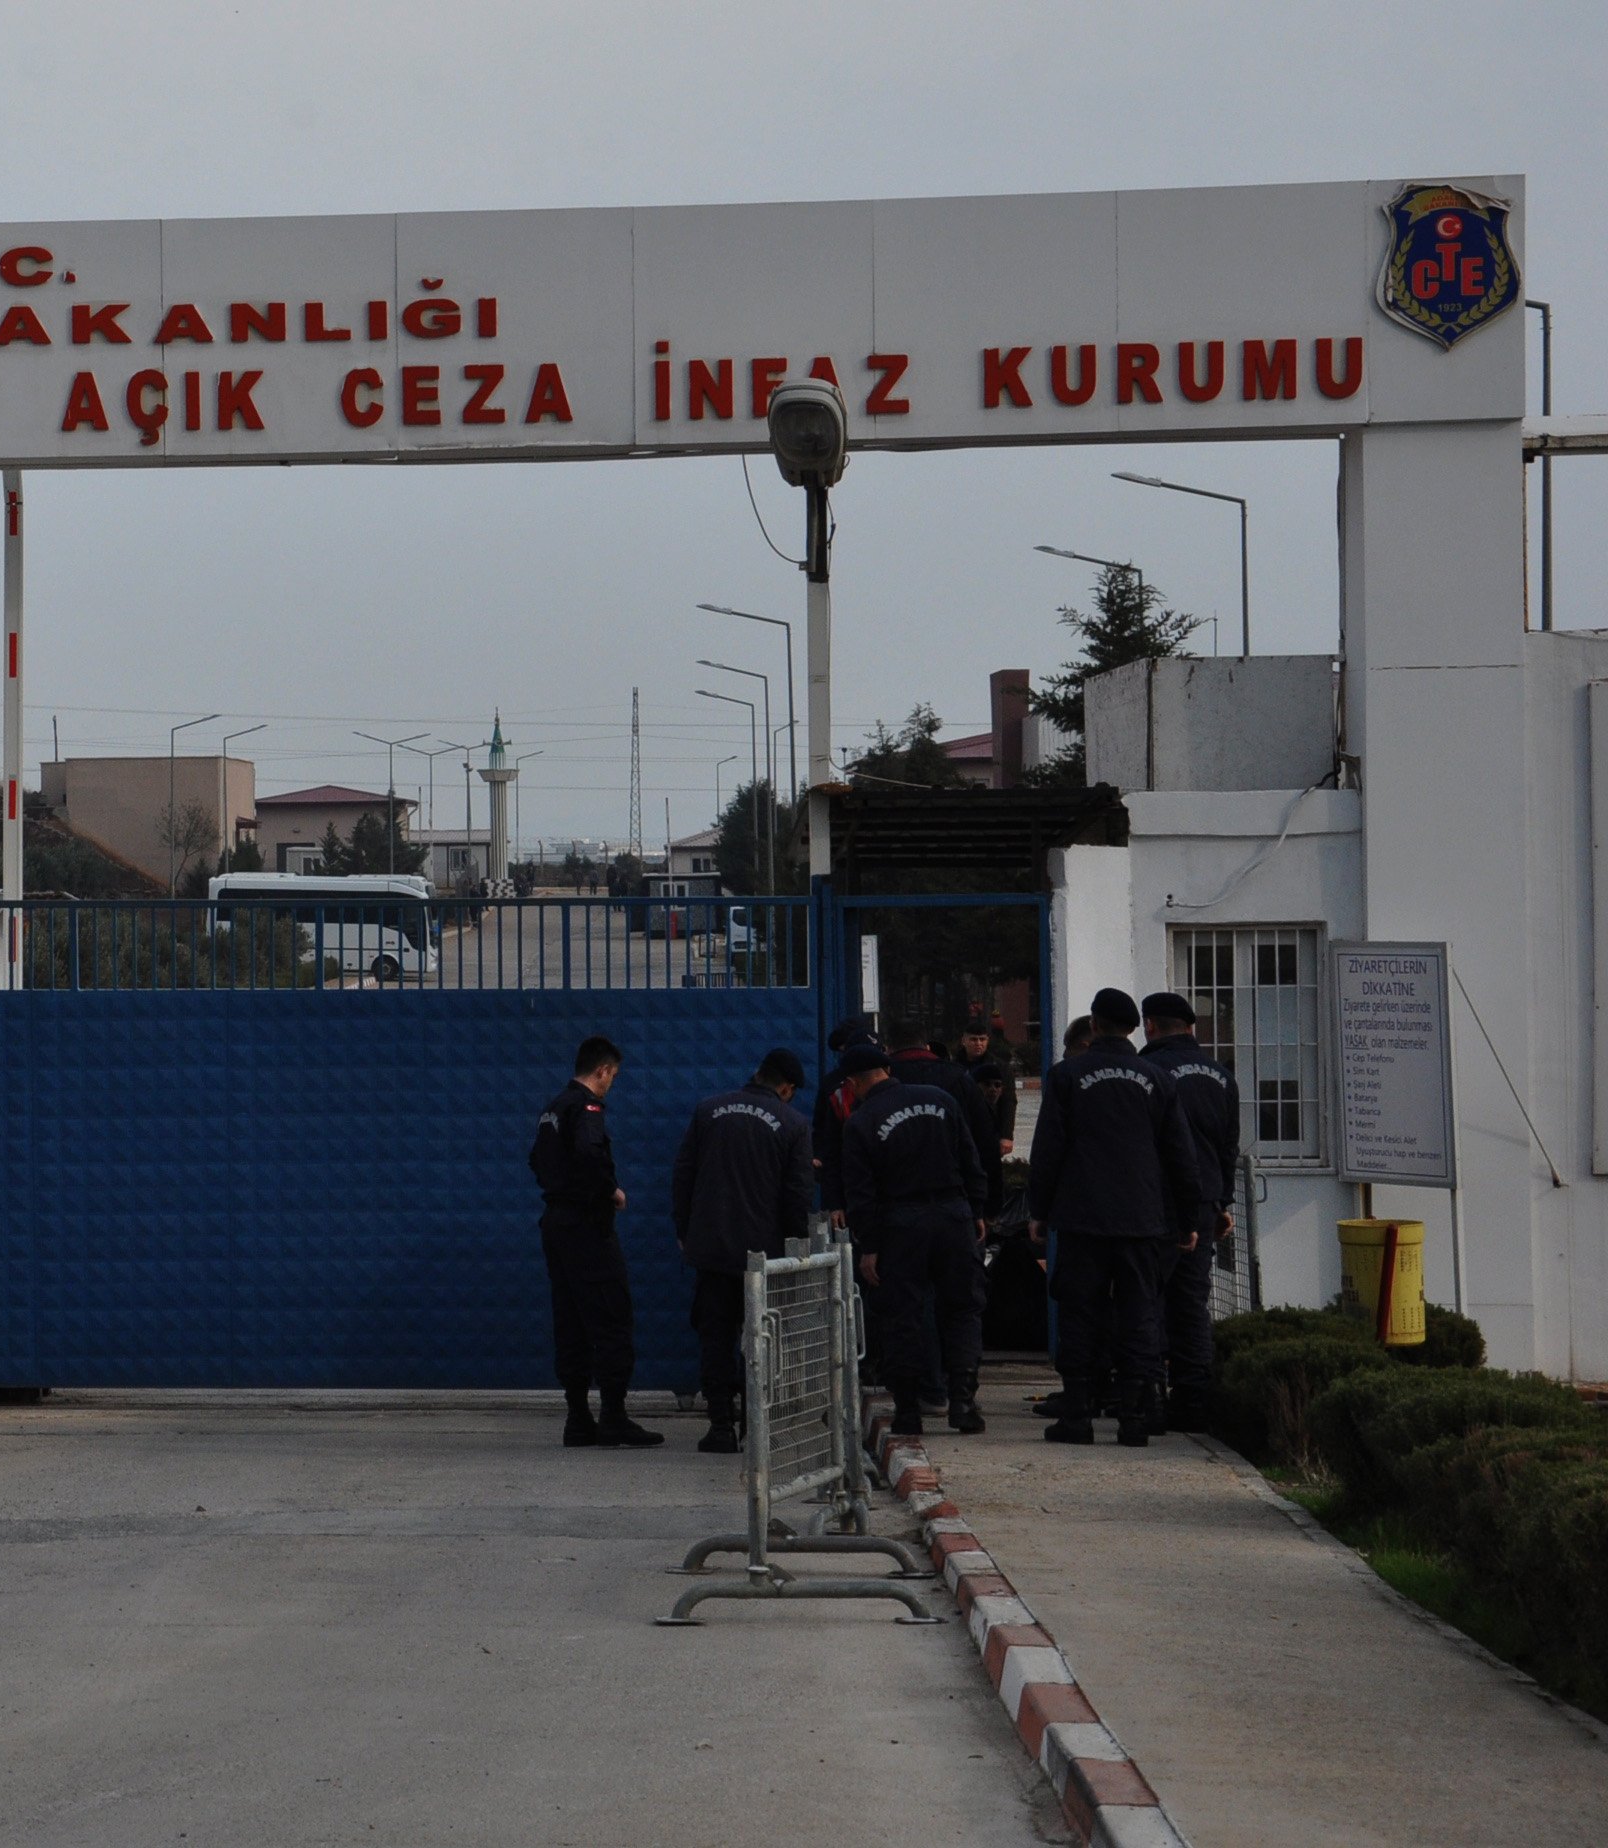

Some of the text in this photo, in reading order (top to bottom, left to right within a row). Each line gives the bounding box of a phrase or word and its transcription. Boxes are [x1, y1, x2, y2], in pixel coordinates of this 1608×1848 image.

[1411, 242, 1485, 299] CTE
[1438, 303, 1463, 313] 1923
[61, 368, 265, 445] AÇIK
[342, 364, 572, 426] CEZA
[985, 338, 1363, 406] KURUMU
[1343, 1020, 1352, 1030] ve
[1079, 1067, 1154, 1095] JANDARMA
[1170, 1063, 1227, 1088] ANDARMA
[711, 1103, 782, 1132] JANDARMA
[877, 1103, 946, 1141] JANDARMA
